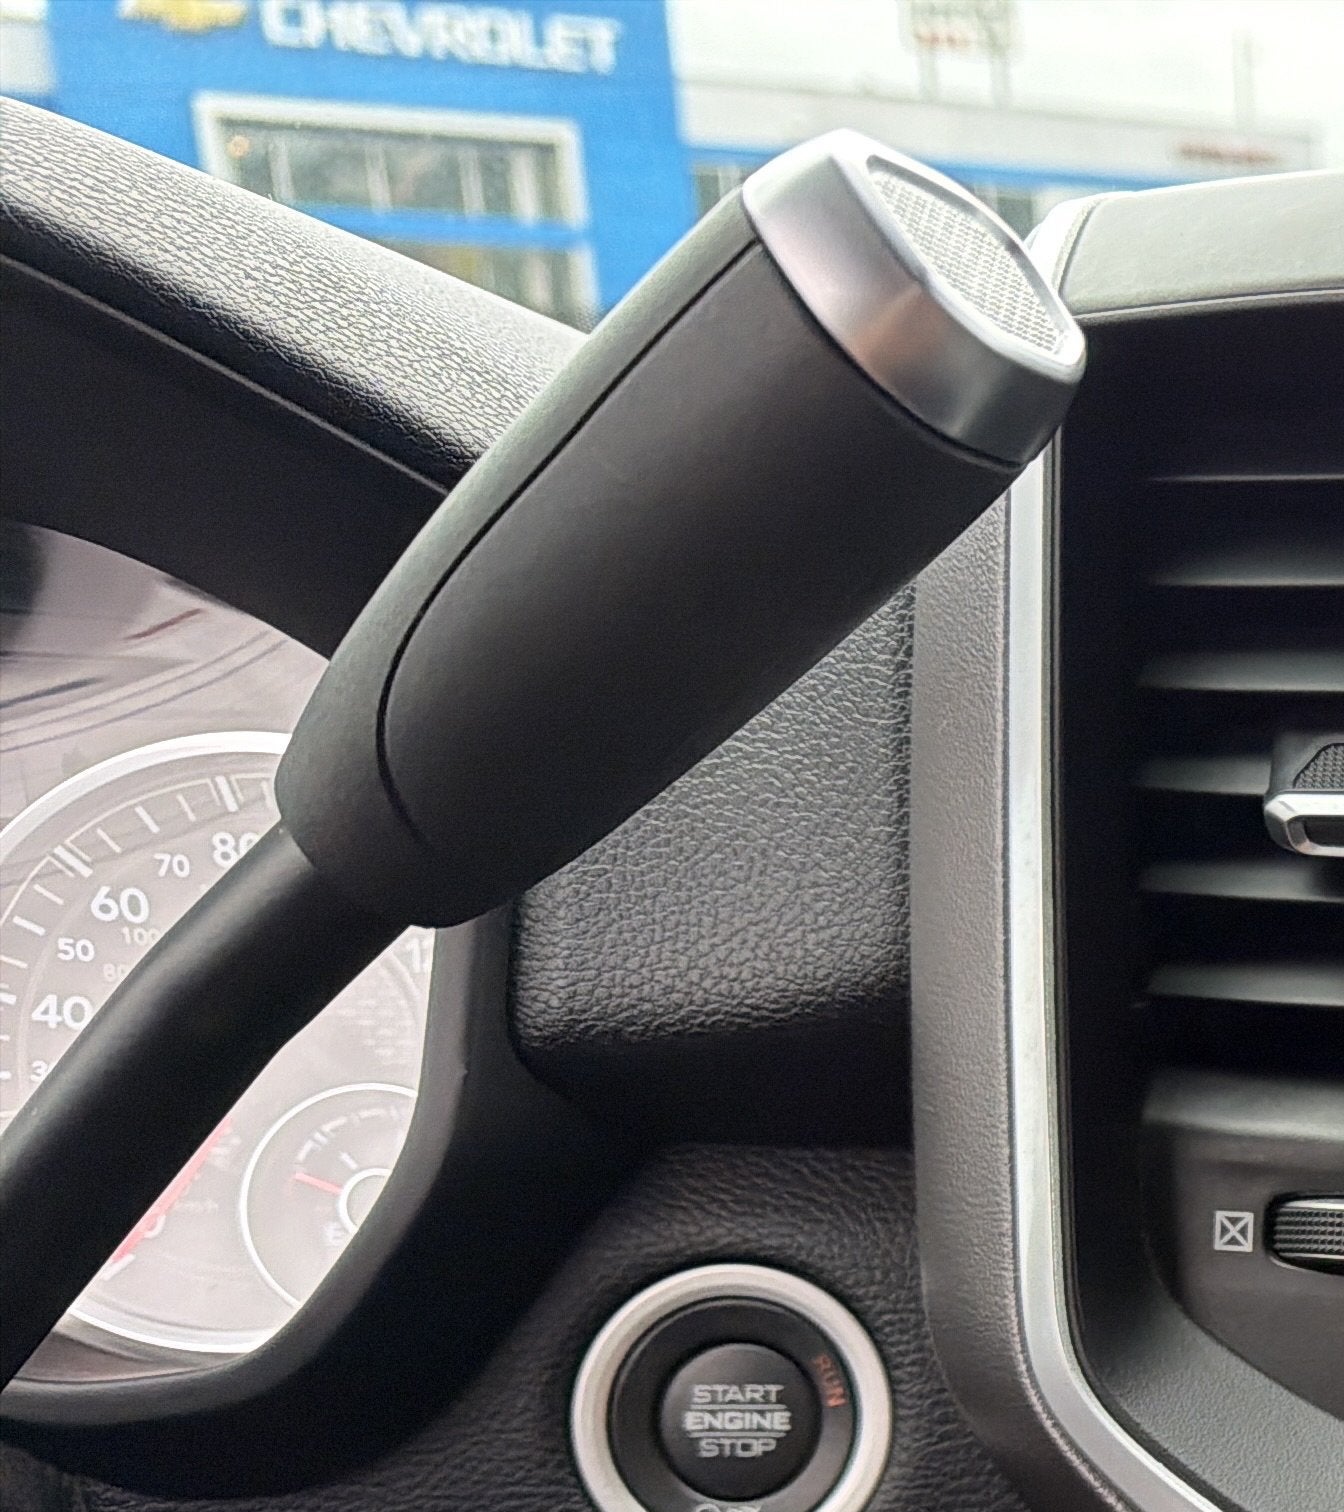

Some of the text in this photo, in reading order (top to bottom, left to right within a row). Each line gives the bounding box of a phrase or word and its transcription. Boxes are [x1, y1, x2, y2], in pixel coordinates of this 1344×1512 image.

[154, 853, 190, 878] 70
[91, 886, 150, 923] 60
[57, 938, 95, 962] 50
[31, 994, 95, 1030] 40
[812, 1354, 847, 1408] RUN
[692, 1384, 784, 1403] START
[684, 1411, 792, 1431] ENGINE
[699, 1438, 777, 1458] STOP
